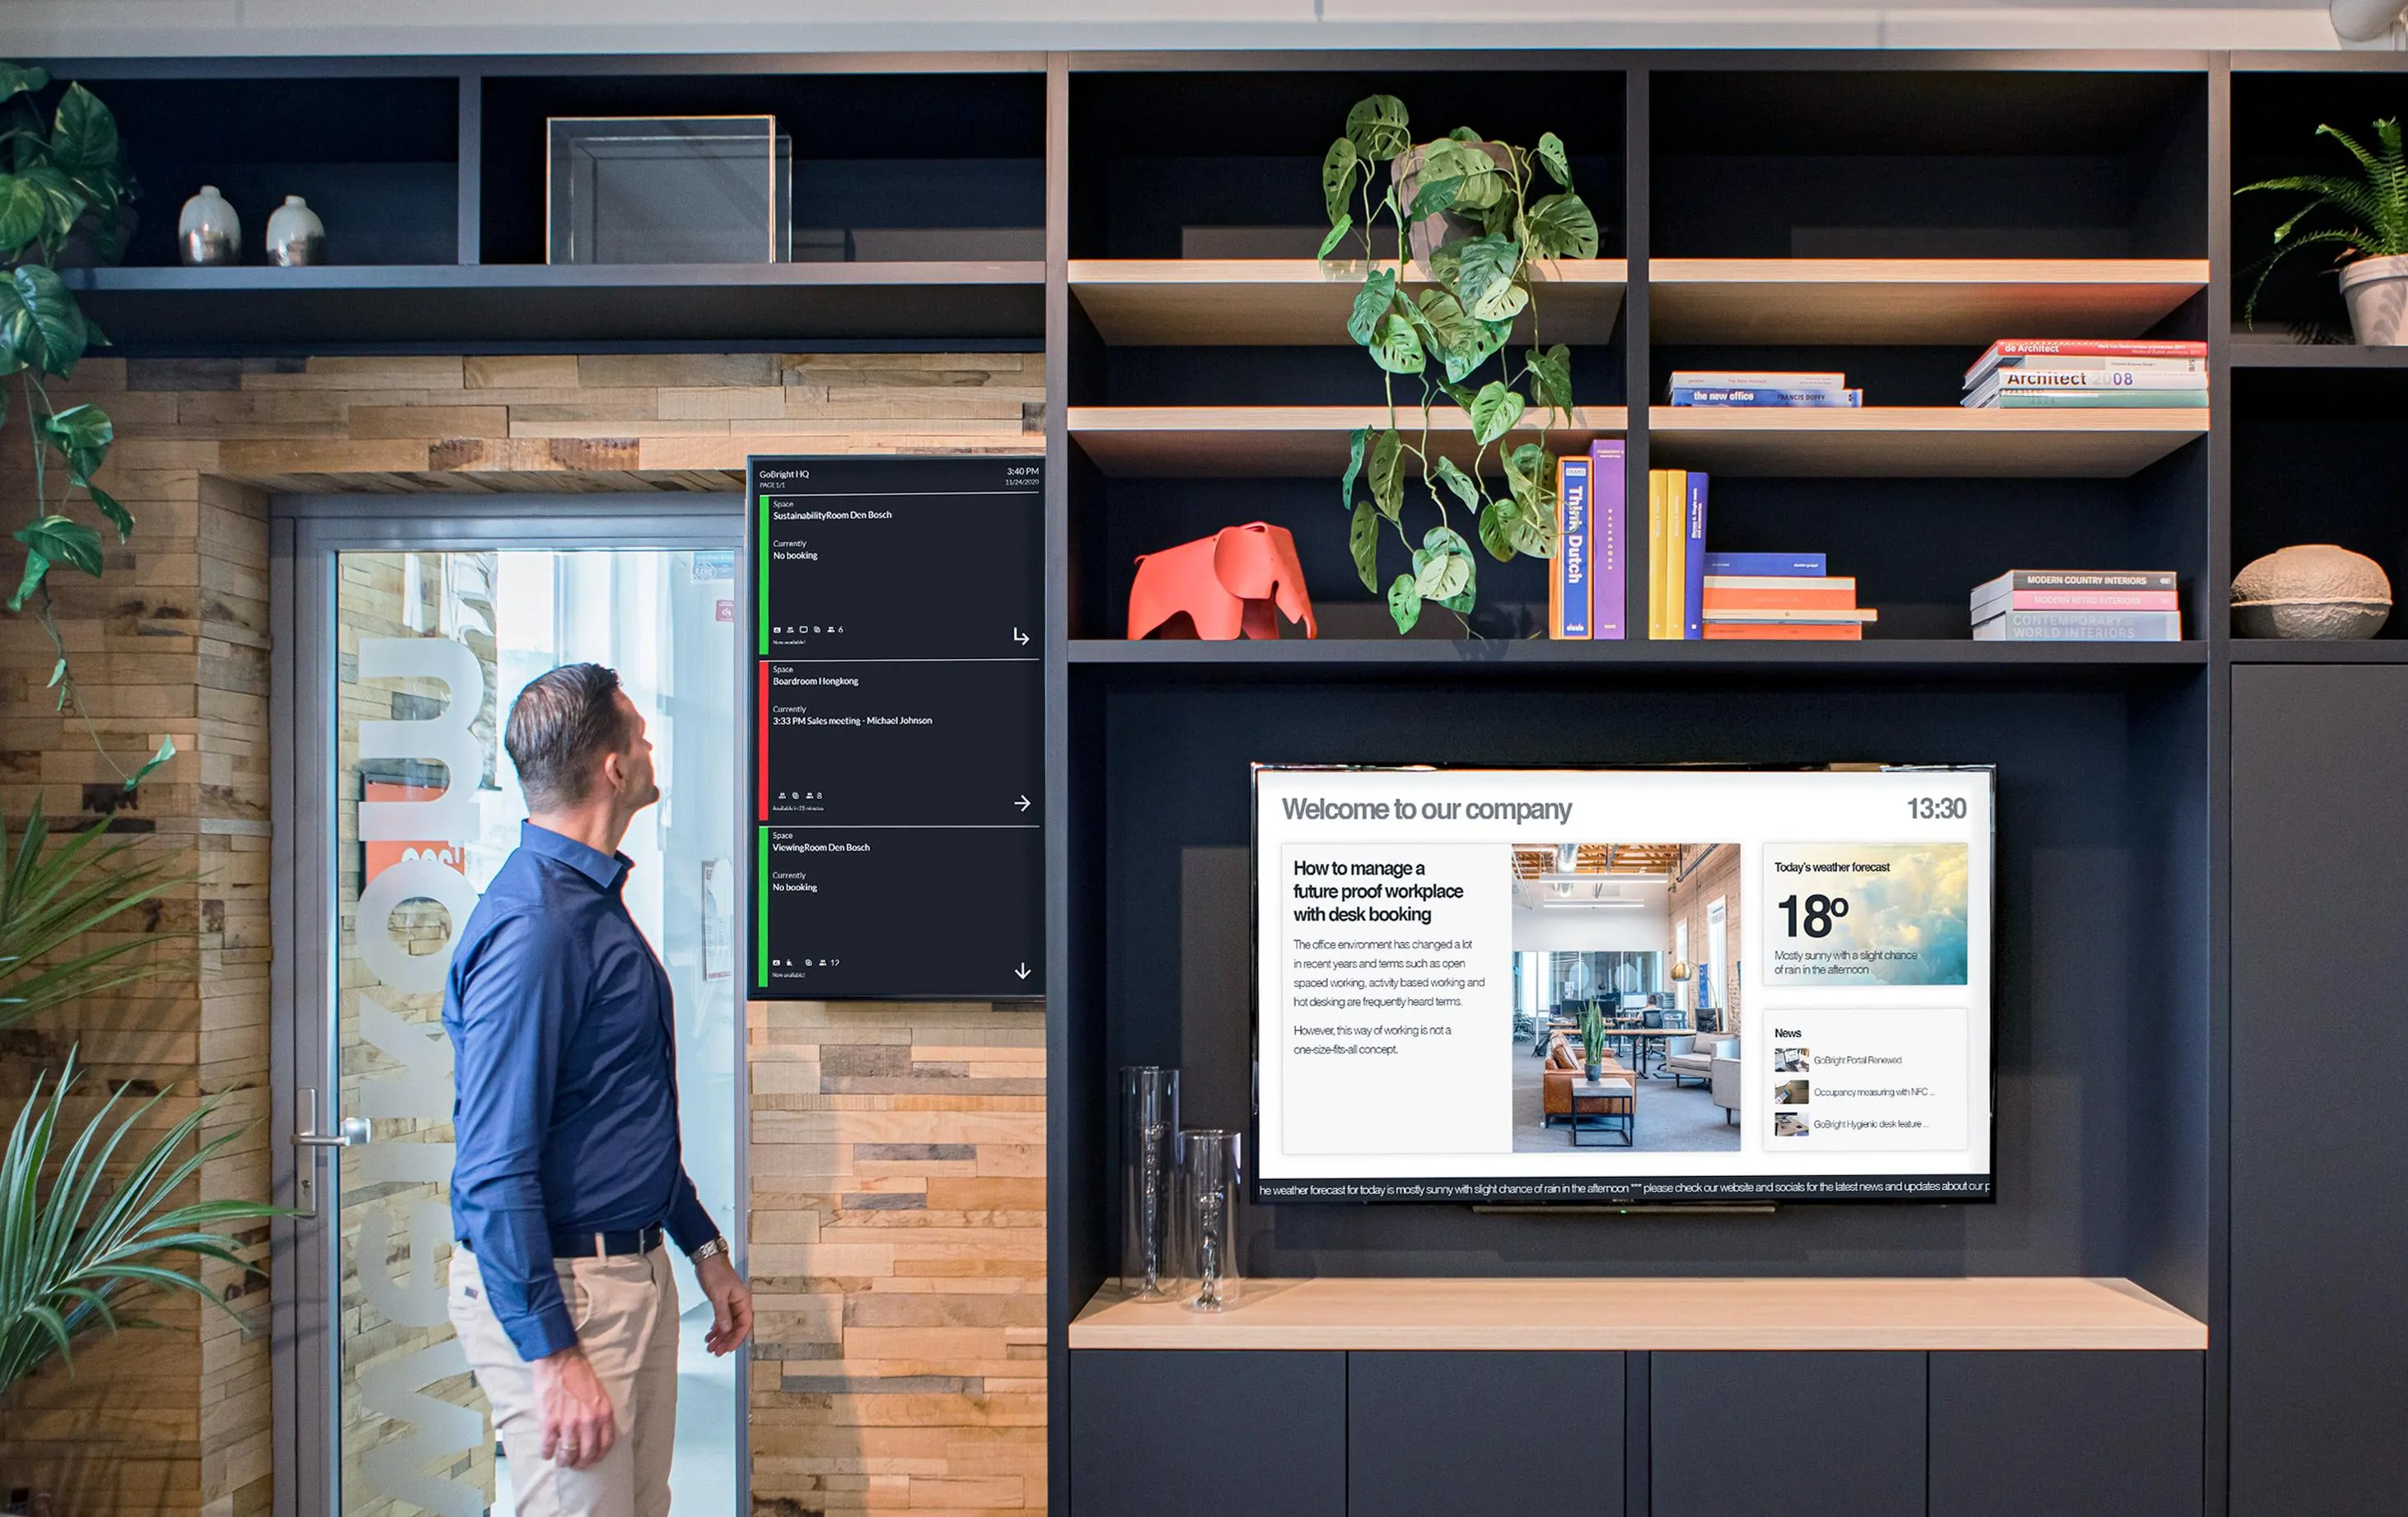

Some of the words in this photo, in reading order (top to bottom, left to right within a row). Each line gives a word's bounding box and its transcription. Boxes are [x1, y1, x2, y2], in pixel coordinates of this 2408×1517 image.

[2005, 344, 2016, 352] de
[2018, 344, 2060, 352] Architect
[2007, 372, 2087, 385] Architect
[2092, 372, 2133, 385] 2008
[1694, 391, 1707, 400] the
[1729, 391, 1754, 400] office
[760, 470, 794, 479] GoBright
[796, 470, 810, 479] HQ
[1007, 467, 1025, 476] 3:40
[1026, 467, 1040, 475] PM
[773, 501, 794, 509] Space
[1569, 486, 1583, 532] Think
[773, 511, 849, 520] SustainabilityRoom
[850, 511, 867, 519] Den
[868, 511, 892, 519] Bosch
[773, 540, 807, 548] Currently
[786, 552, 818, 561] booking
[1569, 535, 1583, 584] Dutch
[2027, 576, 2064, 584] MODERN
[2065, 576, 2102, 585] COUNTRY
[2104, 576, 2147, 585] INTERIORS
[2035, 596, 2070, 604] MODERN
[2072, 596, 2097, 604] RETRO
[2013, 615, 2122, 626] CONTEMPORARY
[2013, 628, 2060, 637] WORLD
[2065, 628, 2135, 638] INTERIORS
[773, 665, 793, 674] Space
[773, 677, 817, 685] Boardroom
[819, 677, 859, 687] Hongkong
[807, 716, 828, 725] Sales
[829, 716, 861, 726] meeting
[867, 716, 898, 725] Michael
[899, 716, 933, 725] Johnson
[1282, 796, 1389, 820] Welcome
[1394, 798, 1417, 820] to
[1421, 802, 1461, 820] our
[1466, 801, 1573, 825] company
[1907, 797, 1967, 819] 13:30
[773, 832, 793, 841] Space
[772, 843, 827, 853] ViewingRoom
[828, 843, 845, 852] Den
[846, 843, 870, 852] Bosch
[1293, 861, 1329, 875] How
[1332, 861, 1348, 875] to
[1350, 864, 1413, 879] manage
[1415, 864, 1425, 875] a
[1774, 862, 1811, 874] Today's
[1812, 862, 1849, 872] weather
[1852, 862, 1891, 872] forecast
[773, 871, 807, 880] Currently
[773, 883, 784, 891] No
[786, 883, 817, 893] booking
[1293, 884, 1339, 899] future
[1341, 884, 1383, 903] proof
[1385, 884, 1464, 902] workplace
[1293, 907, 1326, 922] with
[1329, 907, 1366, 921] desk
[1369, 907, 1432, 925] booking
[1293, 940, 1311, 949] The
[1312, 940, 1336, 949] office
[1338, 940, 1392, 949] environment
[1394, 940, 1410, 949] has
[1412, 940, 1452, 951] changed
[1774, 950, 1803, 962] Mostly
[1805, 953, 1832, 962] sunny
[1833, 950, 1851, 959] with
[1860, 950, 1883, 962] slight
[1884, 950, 1918, 959] chance
[1303, 959, 1331, 969] recent
[1333, 961, 1358, 970] years
[1359, 959, 1377, 969] and
[1378, 959, 1404, 969] terms
[1405, 959, 1427, 969] such
[1442, 961, 1466, 970] open
[1785, 965, 1801, 974] rain
[1812, 965, 1826, 974] the
[1827, 965, 1869, 974] afternoon
[1293, 978, 1328, 989] spaced
[1330, 978, 1367, 989] working,
[1368, 978, 1399, 989] activity
[1400, 978, 1429, 987] based
[1431, 978, 1465, 989] working
[1466, 978, 1485, 987] and
[1293, 997, 1308, 1006] hot
[1310, 997, 1345, 1009] desking
[1363, 997, 1405, 1009] frequently
[1407, 997, 1434, 1006] heard
[1436, 997, 1463, 1006] terms.
[1293, 1025, 1335, 1036] However,
[1337, 1025, 1352, 1035] this
[1354, 1028, 1372, 1038] way
[1384, 1025, 1419, 1037] working
[1429, 1026, 1443, 1034] not
[1774, 1029, 1802, 1038] News
[1293, 1045, 1358, 1054] one-size-fits-all
[1359, 1045, 1398, 1056] concept.
[1814, 1056, 1845, 1066] GoBright
[1868, 1056, 1902, 1064] Renewed
[1814, 1088, 1856, 1098] Occupancy
[1857, 1088, 1895, 1097] measuring
[1814, 1120, 1846, 1130] GoBright
[1847, 1120, 1878, 1130] Hygienic
[1897, 1120, 1922, 1128] feature
[1274, 1185, 1308, 1195] weather
[1310, 1185, 1346, 1194] forecast
[1347, 1185, 1358, 1194] for
[1360, 1185, 1386, 1197] today
[1396, 1185, 1424, 1197] mostly
[1426, 1186, 1454, 1196] sunny
[1455, 1184, 1473, 1194] with
[1474, 1184, 1498, 1196] slight
[1499, 1184, 1532, 1193] chance
[1545, 1184, 1561, 1193] rain
[1572, 1184, 1586, 1193] the
[1587, 1183, 1629, 1193] afternoon
[1644, 1183, 1673, 1194] please
[1675, 1183, 1702, 1193] check
[1720, 1183, 1754, 1193] website
[1755, 1183, 1774, 1192] and
[1775, 1182, 1804, 1192] socials
[1807, 1182, 1818, 1191] for
[1820, 1182, 1834, 1191] the
[1835, 1182, 1859, 1191] latest
[1885, 1182, 1902, 1191] and
[1905, 1181, 1941, 1193] updates
[1942, 1182, 1967, 1191] about
[1968, 1183, 1984, 1191] our
